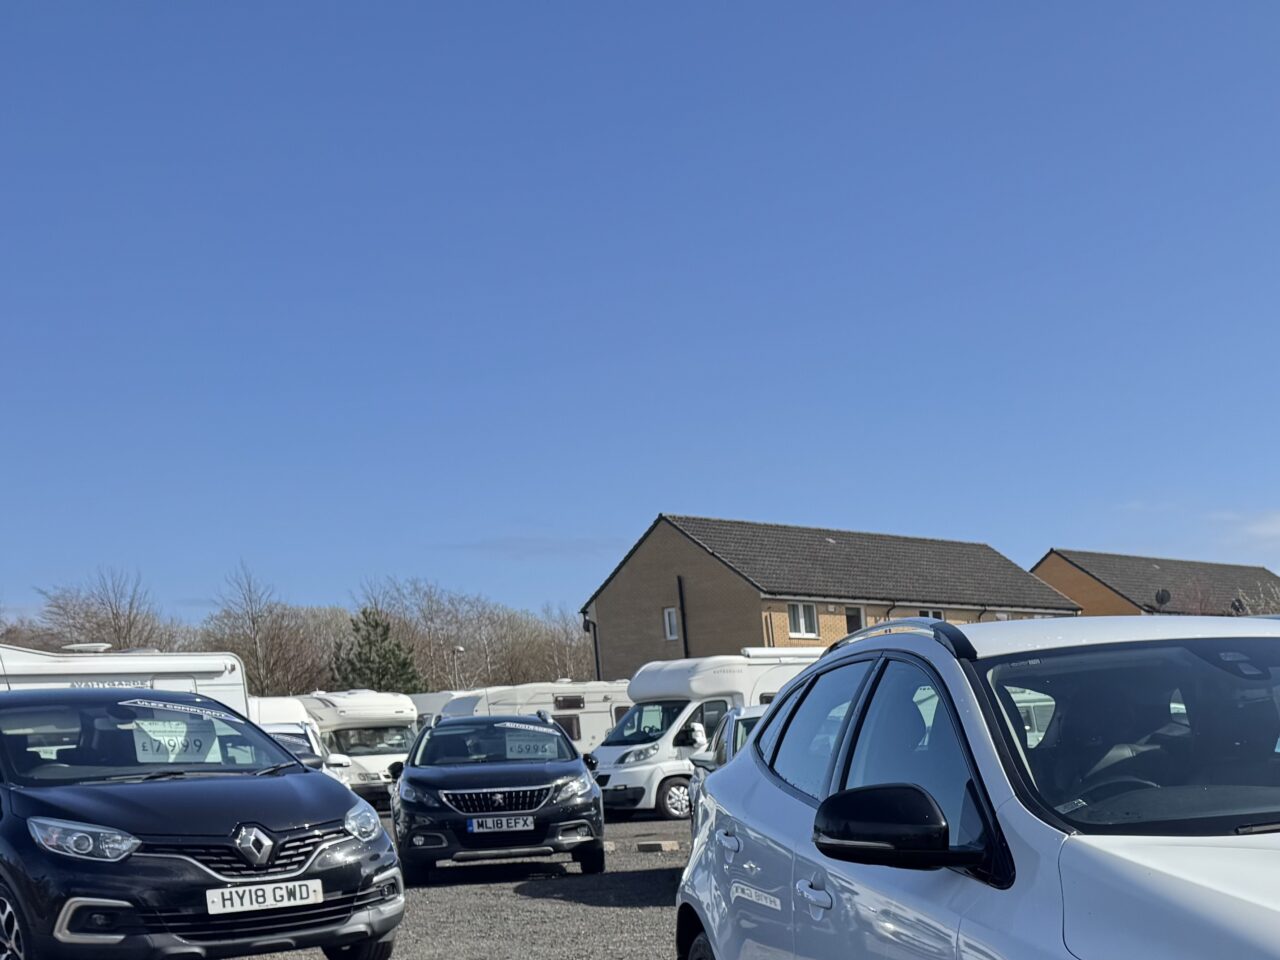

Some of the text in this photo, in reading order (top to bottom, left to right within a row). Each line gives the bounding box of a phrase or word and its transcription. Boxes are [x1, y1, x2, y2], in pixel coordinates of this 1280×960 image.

[477, 817, 529, 830] ML18 EFX
[221, 884, 310, 908] HY18 GWD
